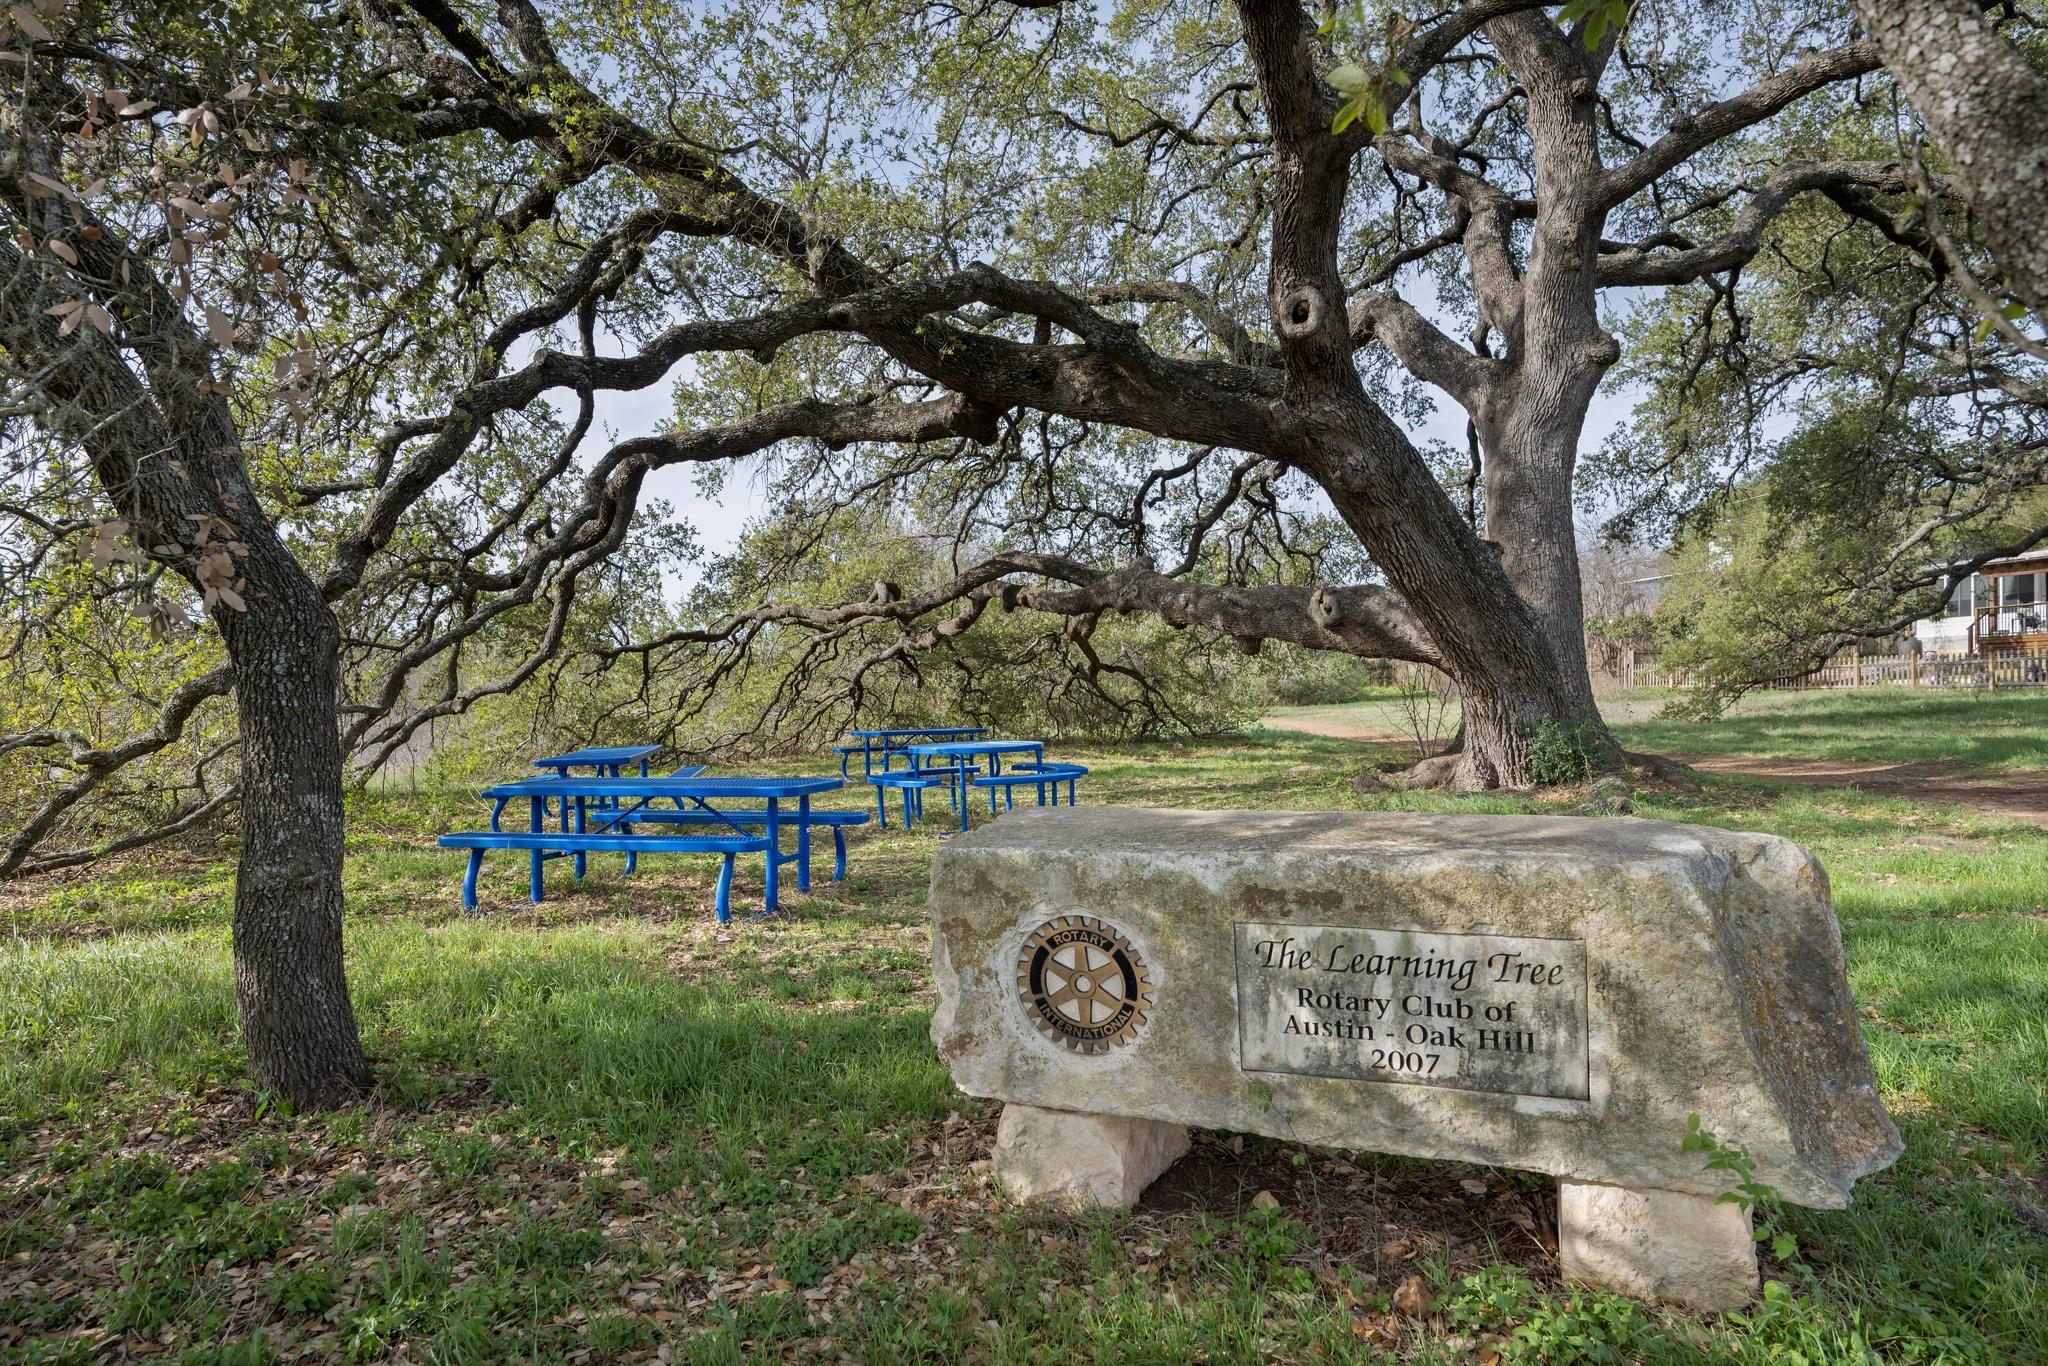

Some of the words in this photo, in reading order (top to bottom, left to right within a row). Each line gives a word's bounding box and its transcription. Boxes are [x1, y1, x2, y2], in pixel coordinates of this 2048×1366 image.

[1053, 931, 1109, 947] ROTARY
[1255, 938, 1312, 970] The
[1323, 945, 1476, 991] Learning
[1488, 952, 1565, 986] Tree
[1296, 987, 1391, 1019] Rotary
[1402, 994, 1474, 1021] Club
[1484, 1001, 1517, 1022] of
[1040, 1006, 1133, 1039] INTERNATIONAL
[1283, 1015, 1374, 1041] Austin
[1405, 1023, 1466, 1048] Oak
[1478, 1029, 1535, 1053] Hill
[1371, 1049, 1440, 1074] 2007
